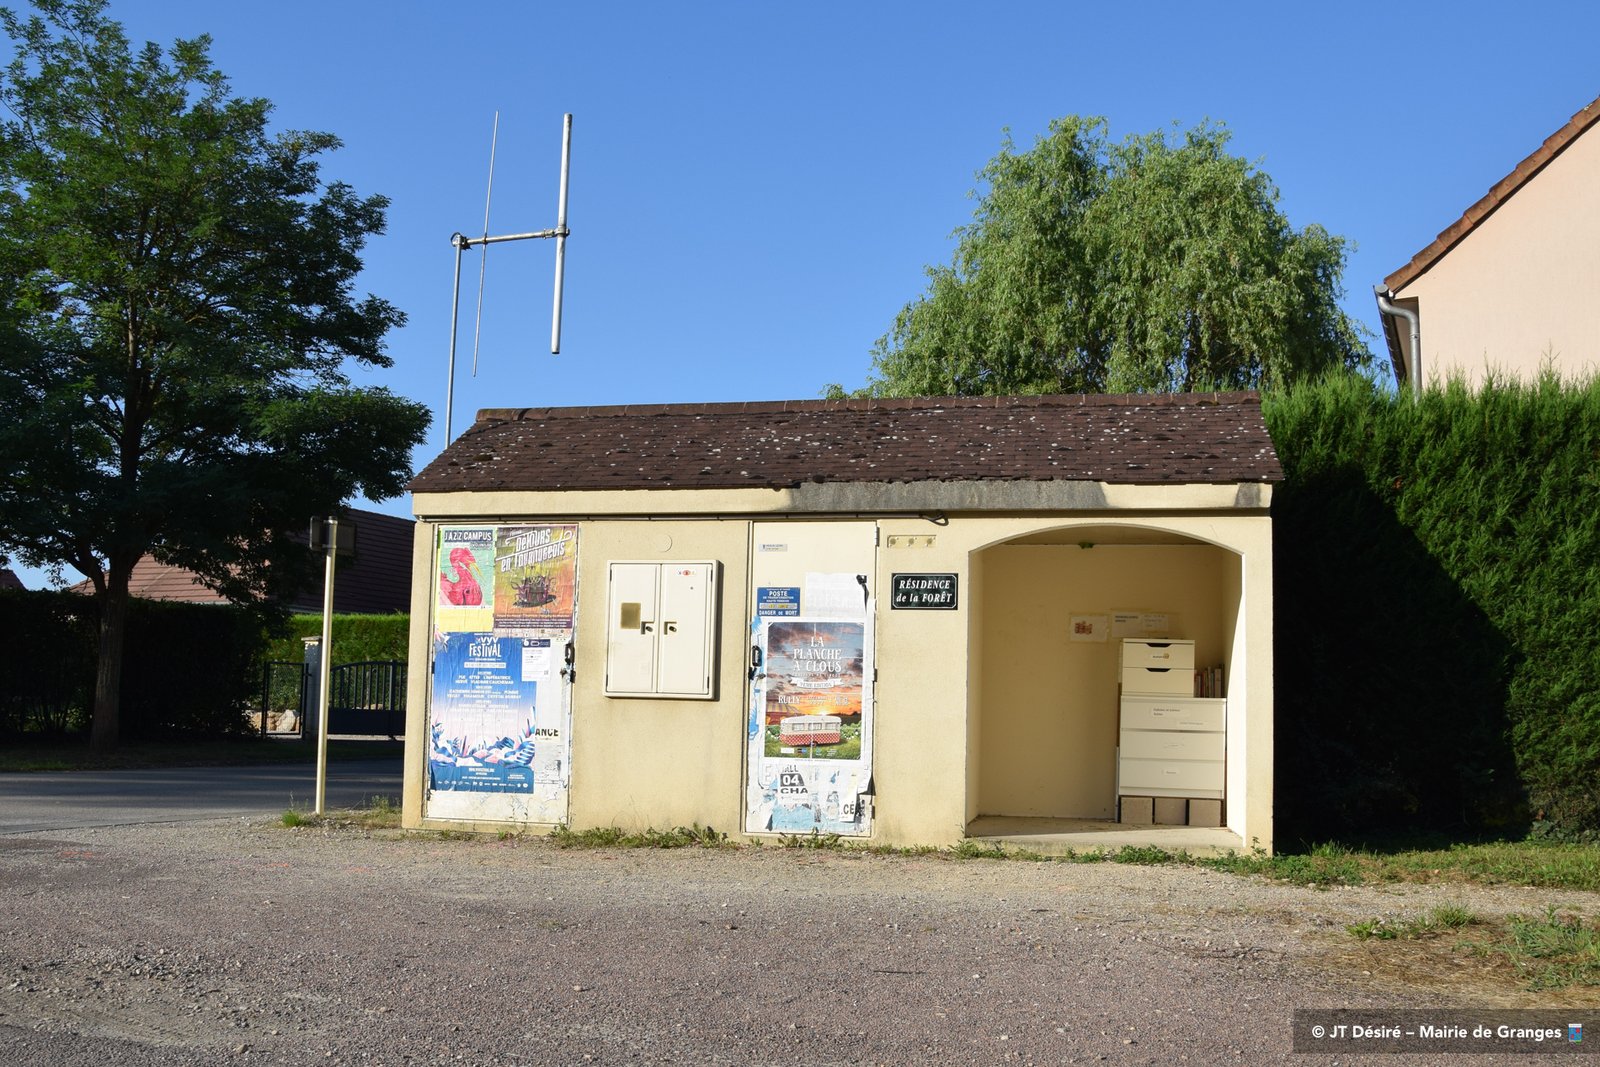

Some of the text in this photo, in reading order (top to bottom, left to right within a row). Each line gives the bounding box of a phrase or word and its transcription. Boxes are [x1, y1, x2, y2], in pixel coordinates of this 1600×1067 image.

[444, 530, 492, 541] JAZZ CAMPUS
[899, 578, 950, 589] RÉSIDENCE
[896, 591, 952, 602] de la FORÊT
[810, 637, 824, 647] LA
[794, 648, 842, 660] PLANCHE
[806, 660, 842, 672] CLOUS
[778, 695, 800, 704] RULLY
[783, 775, 799, 785] 04
